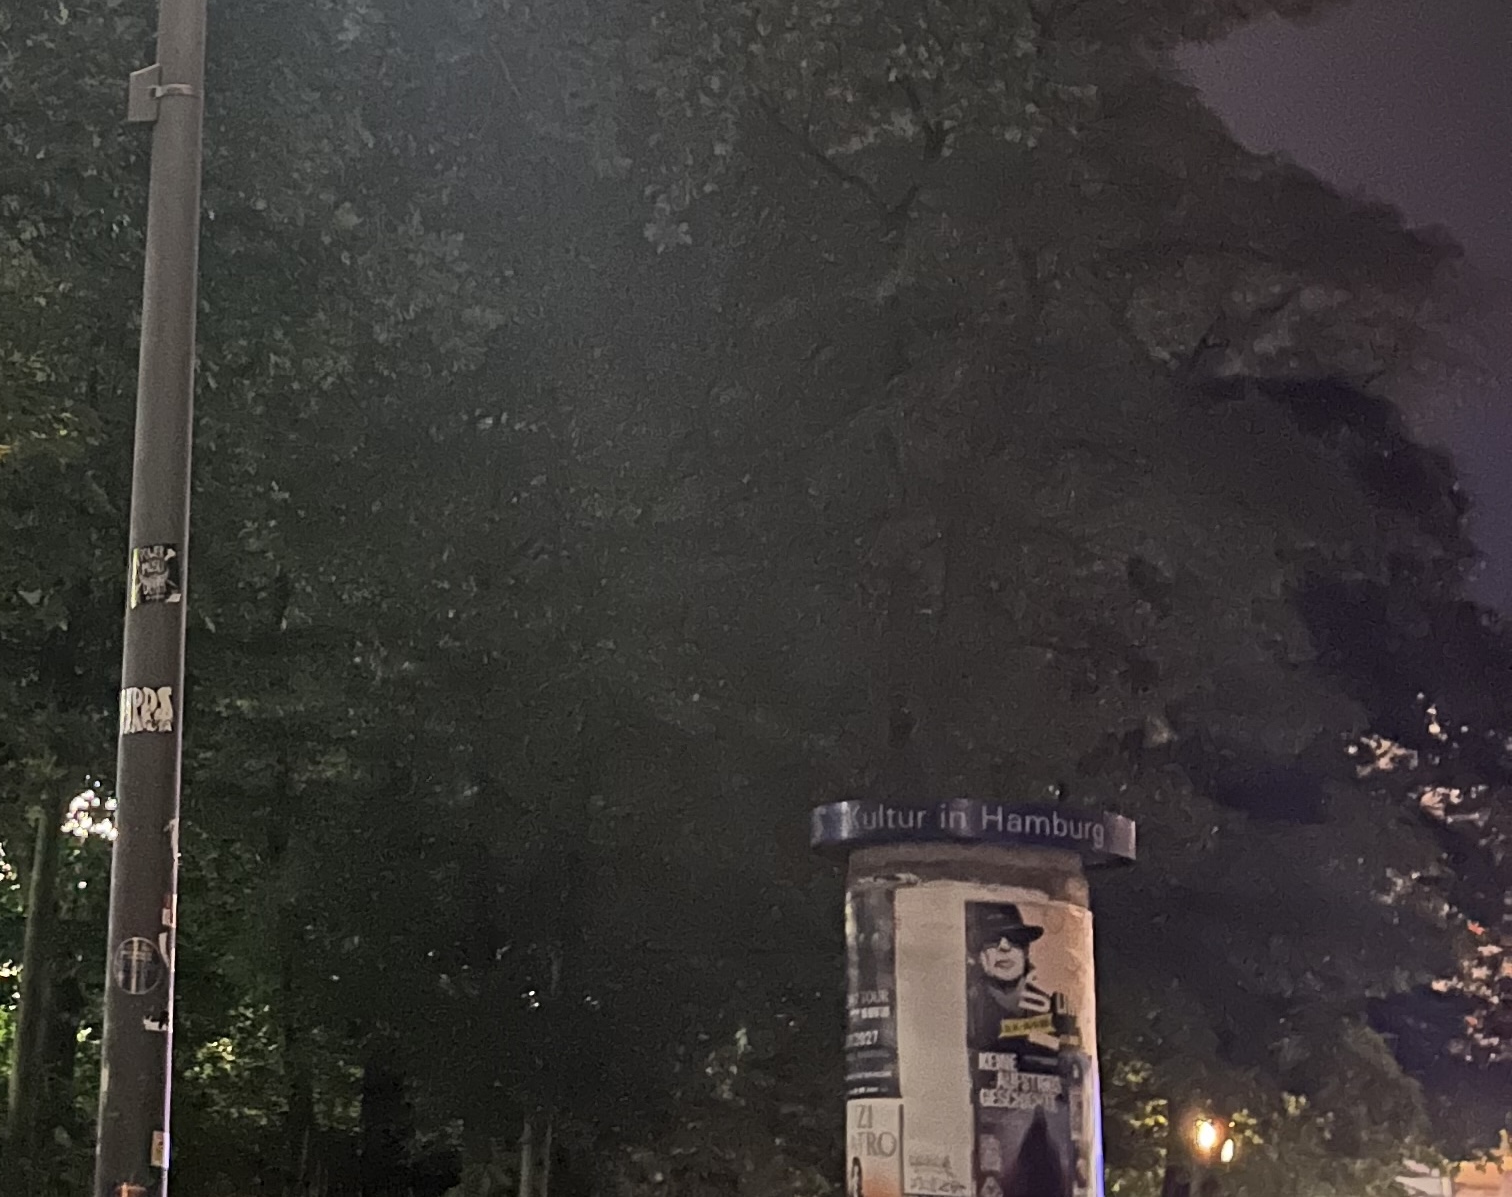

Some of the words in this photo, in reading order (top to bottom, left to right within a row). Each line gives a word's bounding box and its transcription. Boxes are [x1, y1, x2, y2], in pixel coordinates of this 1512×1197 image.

[846, 802, 926, 830] Kultur
[940, 803, 967, 829] in
[982, 805, 1104, 849] Hamburg
